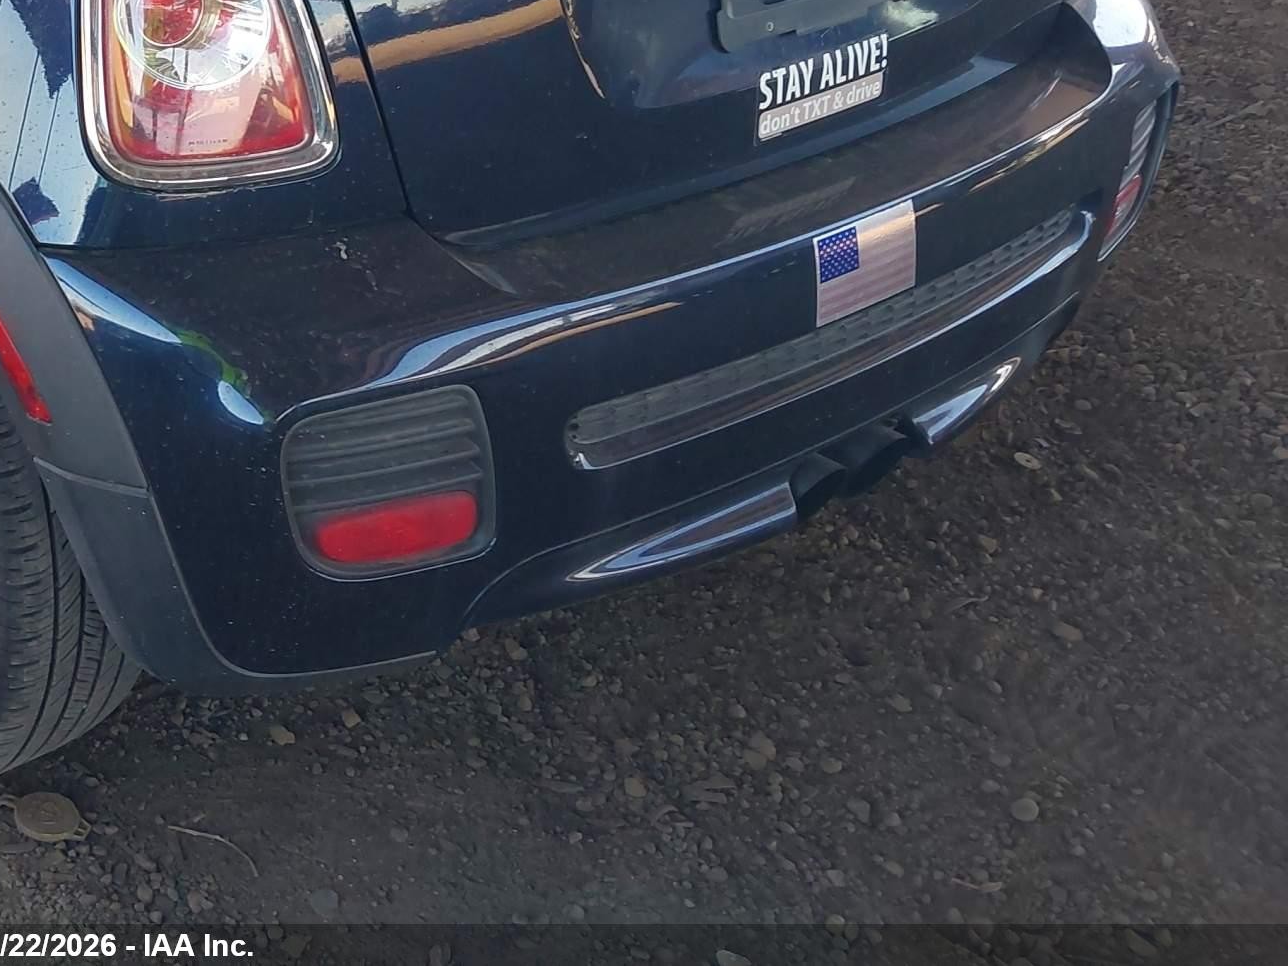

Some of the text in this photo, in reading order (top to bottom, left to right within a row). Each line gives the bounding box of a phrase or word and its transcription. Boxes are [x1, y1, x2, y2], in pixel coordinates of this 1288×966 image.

[759, 33, 888, 109] STAY ALIVE!
[760, 81, 880, 134] don't TXT & drive
